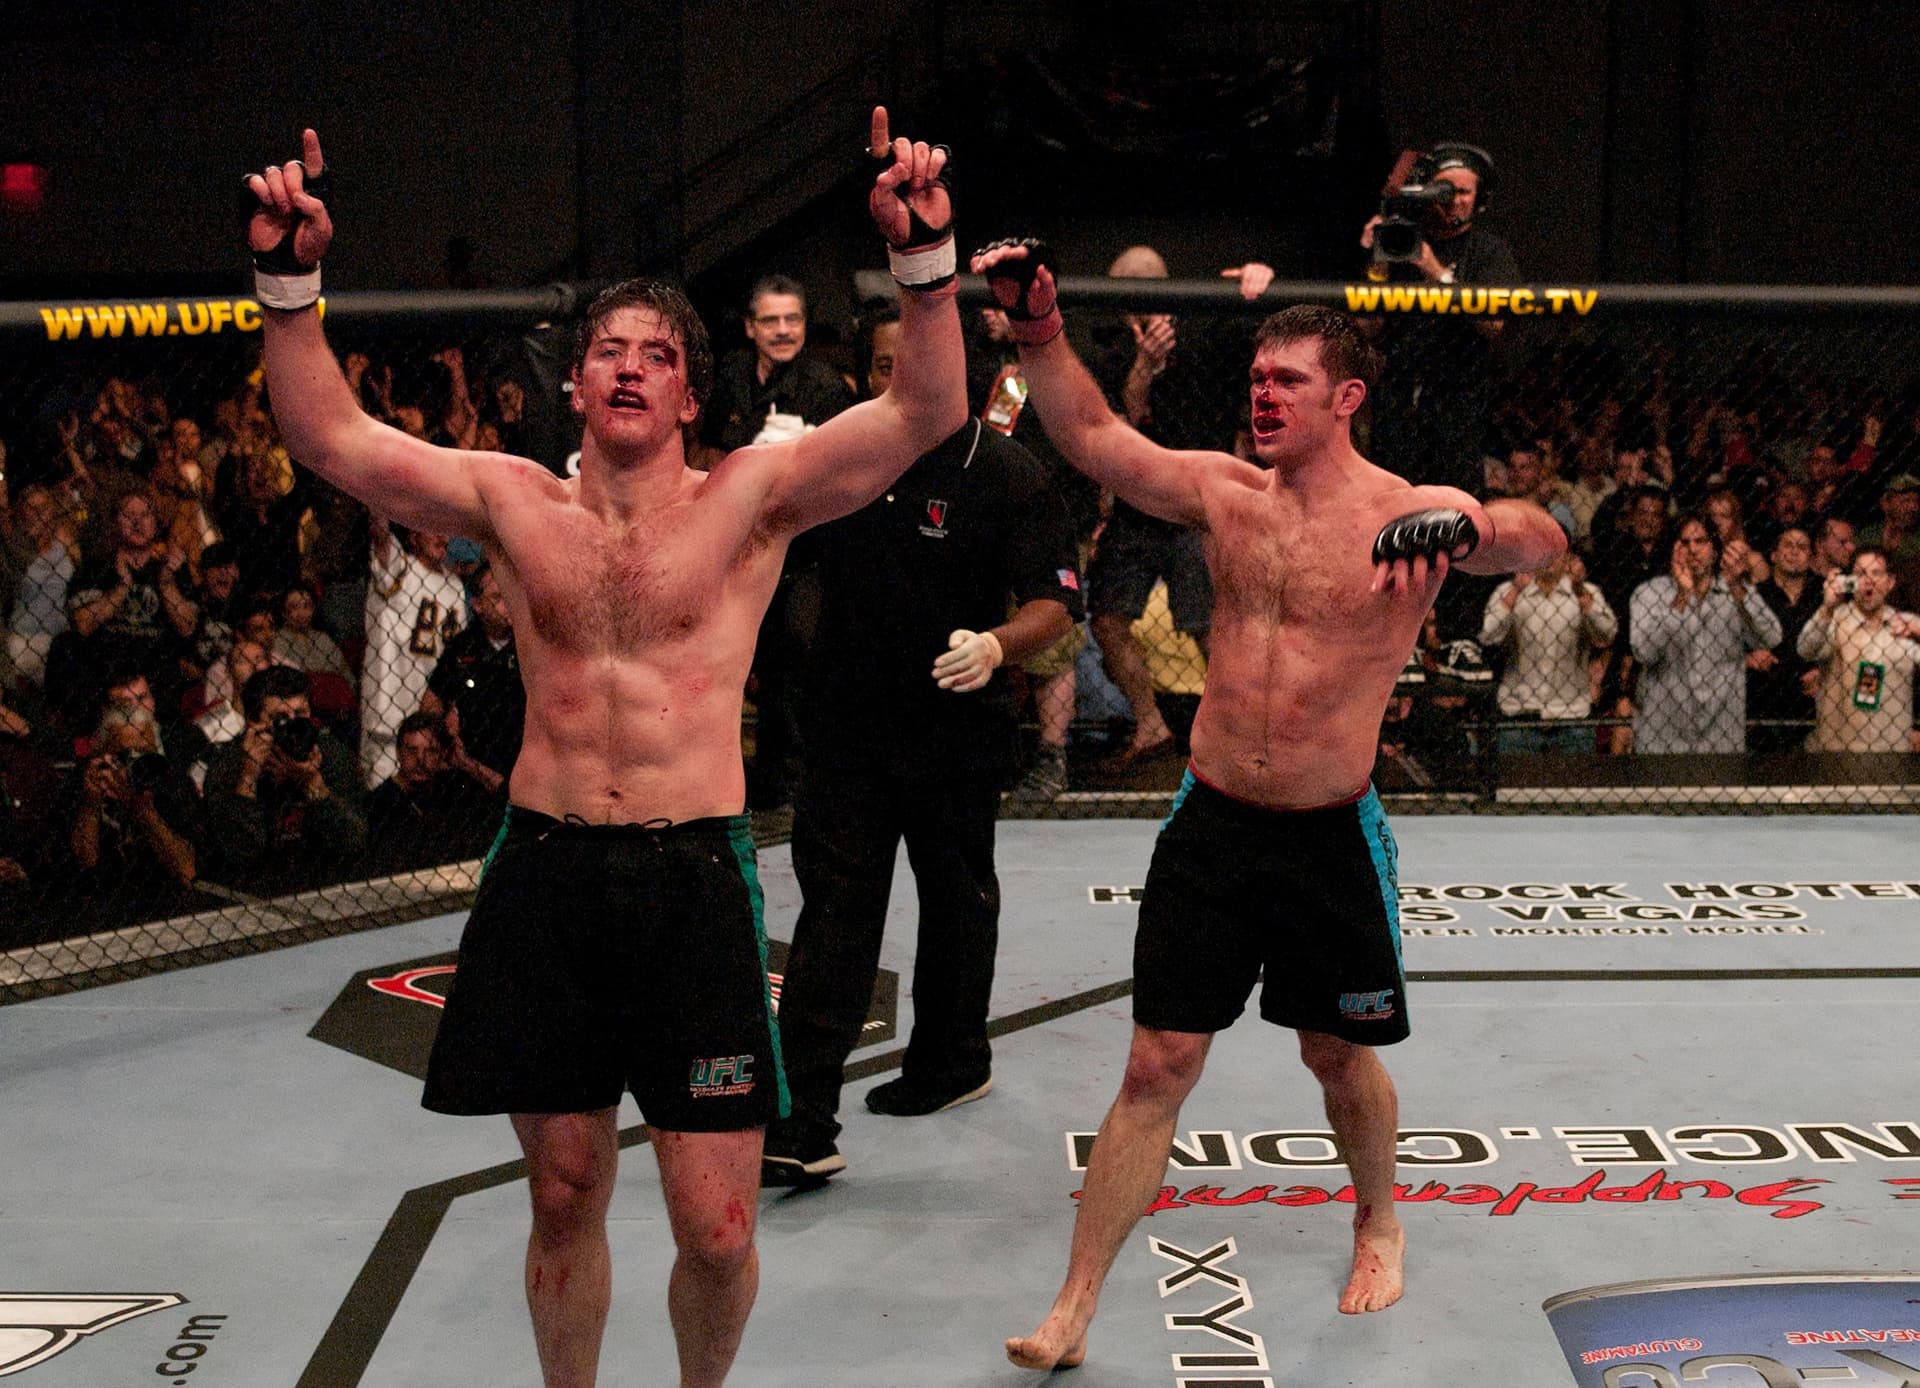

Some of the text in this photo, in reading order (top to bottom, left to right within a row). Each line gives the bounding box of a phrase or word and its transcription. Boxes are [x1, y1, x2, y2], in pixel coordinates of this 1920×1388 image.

[1345, 285, 1598, 315] WWW.UFC.TV
[1488, 903, 1808, 924] VEGAS
[1339, 988, 1395, 1013] UFC
[689, 1054, 755, 1086] UFC
[155, 1314, 229, 1386] .com
[1582, 1336, 1704, 1366] GLUTAMINE
